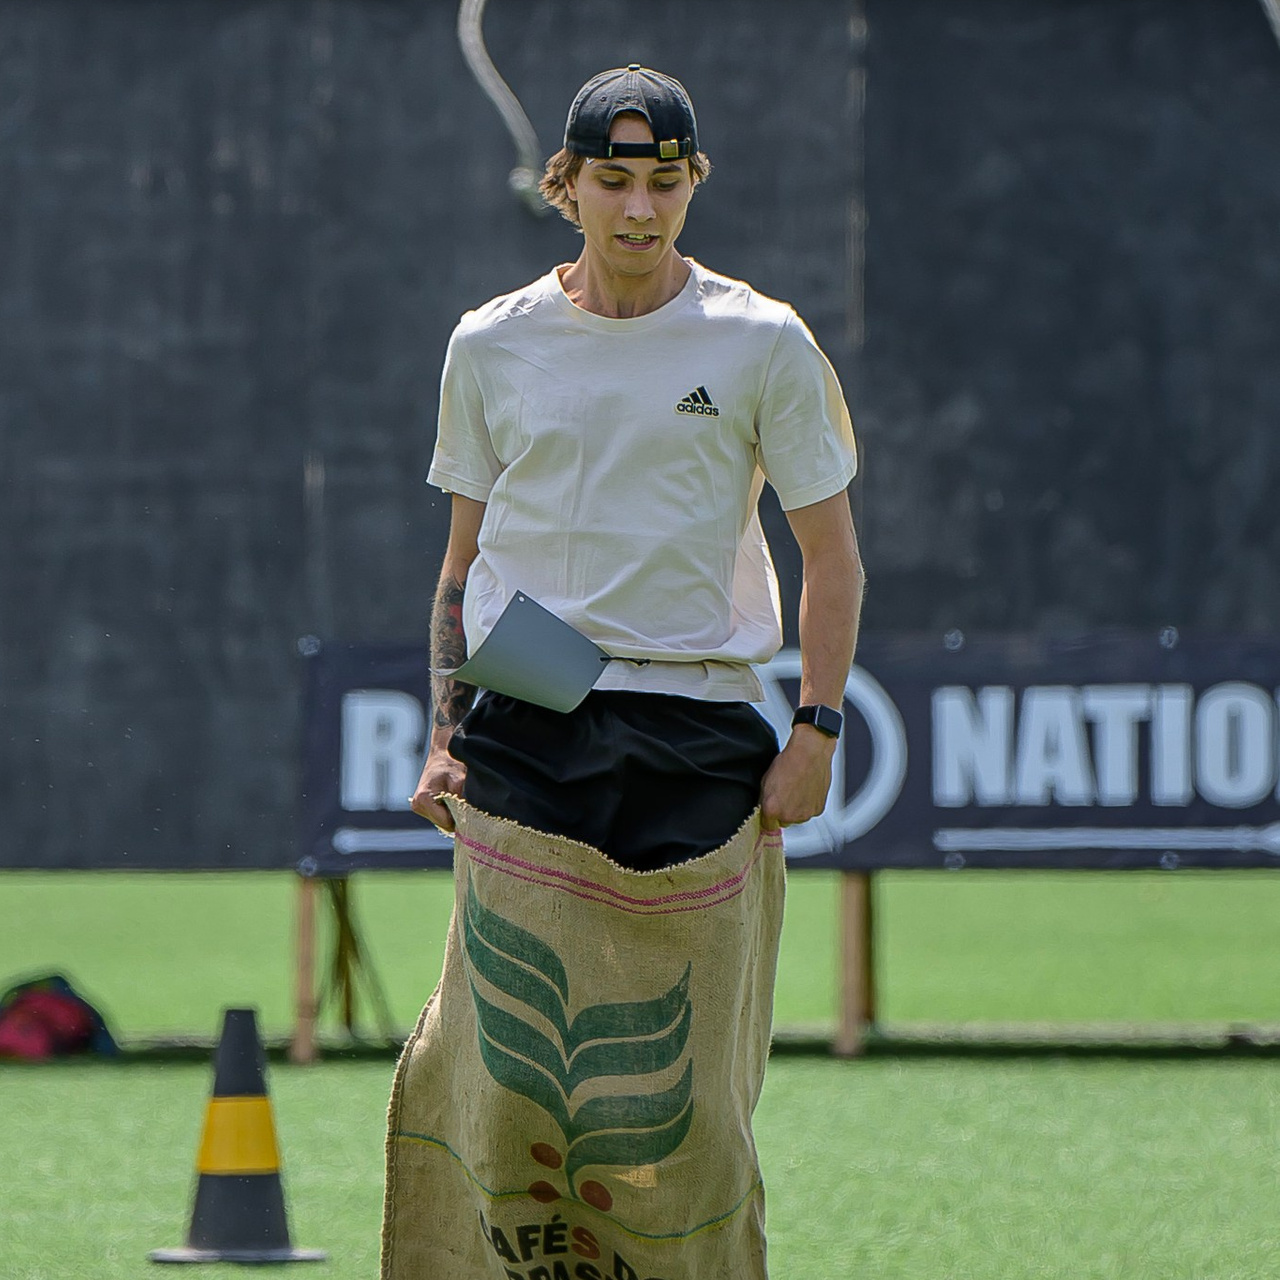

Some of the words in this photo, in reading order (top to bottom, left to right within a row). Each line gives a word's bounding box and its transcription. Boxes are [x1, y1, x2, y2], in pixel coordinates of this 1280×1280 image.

[676, 402, 719, 417] adidas
[931, 680, 1280, 809] NATIO
[478, 1210, 601, 1263] AFÉS
